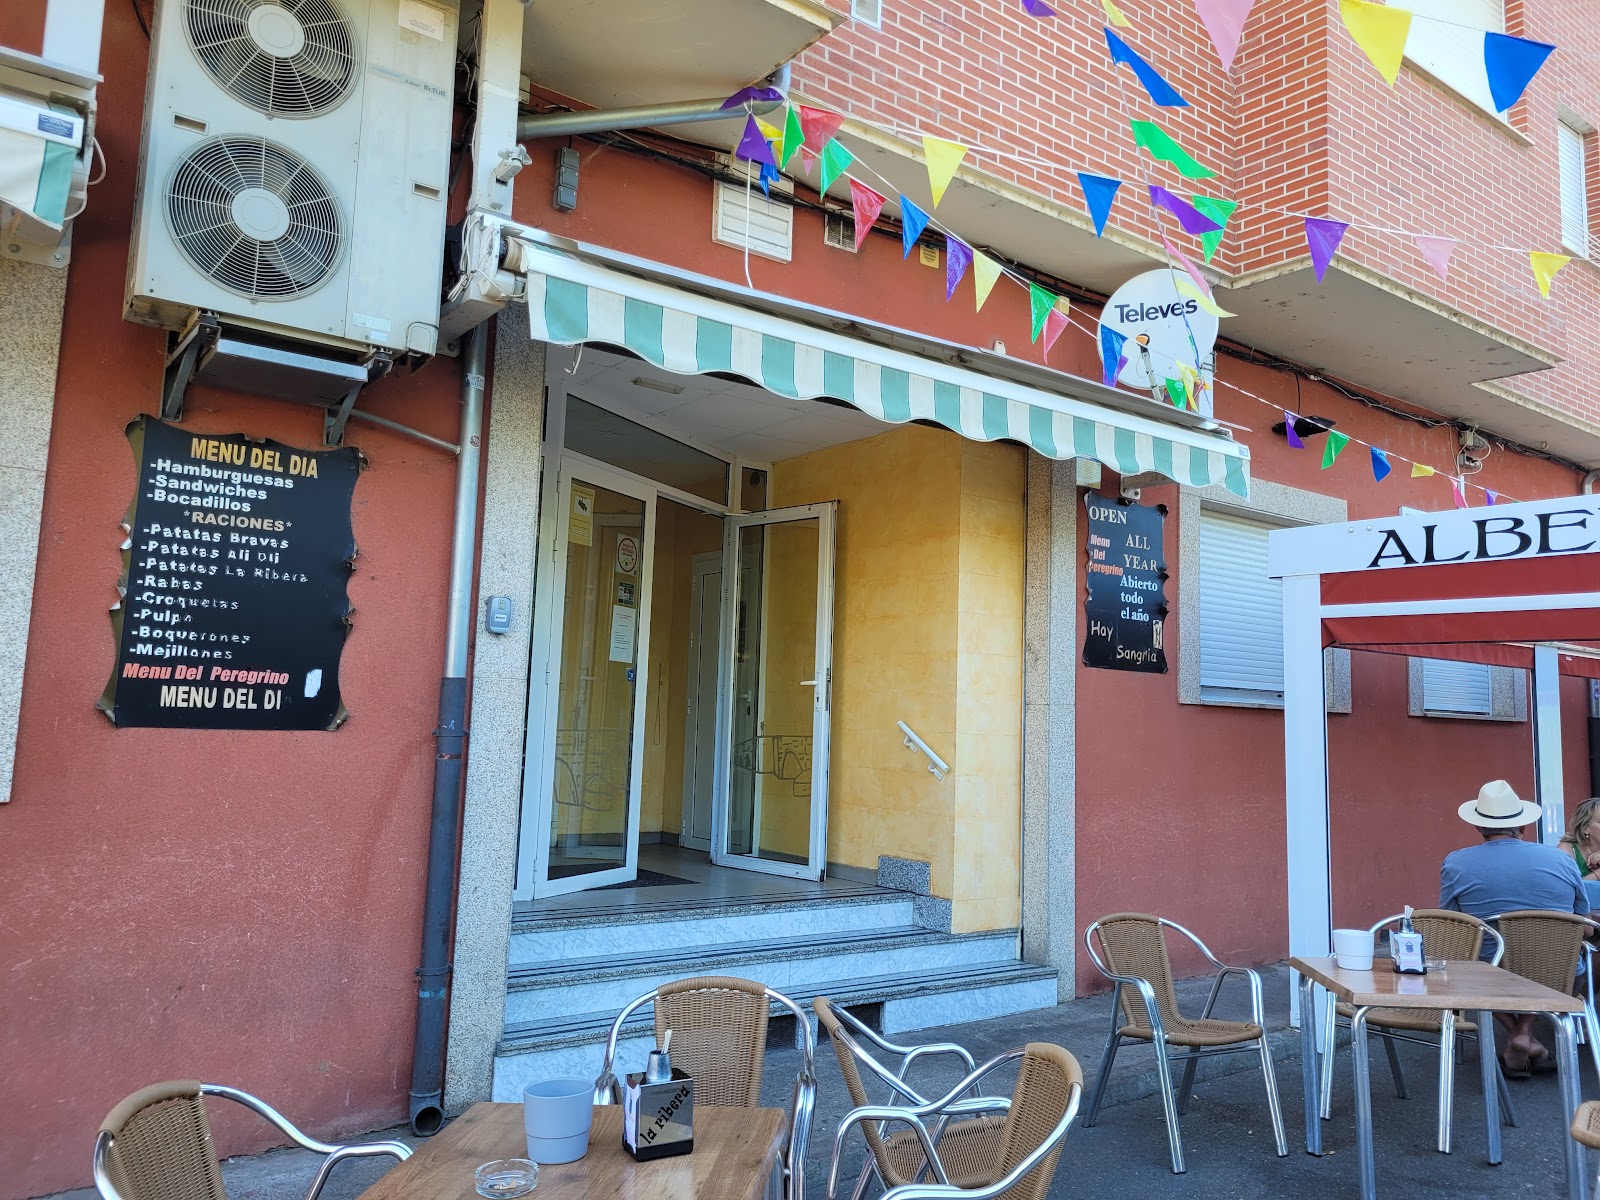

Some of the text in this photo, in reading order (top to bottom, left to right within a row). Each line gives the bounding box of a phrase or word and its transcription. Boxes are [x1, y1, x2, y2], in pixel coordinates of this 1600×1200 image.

[1114, 299, 1198, 323] Televes
[191, 438, 319, 479] MENU DEL DIA
[150, 459, 294, 489] -Hamburguesas
[149, 475, 268, 500] -Sandwiches
[147, 489, 251, 512] -Bocadillos
[1089, 505, 1127, 525] OPEN
[143, 524, 290, 550] -Patatas Bravas
[1090, 534, 1111, 548] Menu
[1125, 533, 1151, 550] ALL
[1367, 508, 1600, 568] ALBE
[141, 540, 220, 559] -Patatas
[1093, 548, 1106, 561] Del
[139, 558, 309, 583] -Patatas La Ribera
[1123, 554, 1158, 572] YEAR
[137, 575, 203, 591] -Rabas
[1120, 574, 1158, 592] Abierto
[1120, 592, 1144, 605] todo
[1121, 606, 1150, 622] el año
[1091, 619, 1114, 642] Hay
[123, 662, 290, 685] Menu Del Peregrino
[159, 685, 218, 708] MENU
[222, 687, 258, 709] DEL
[639, 1085, 690, 1145] la ribera
